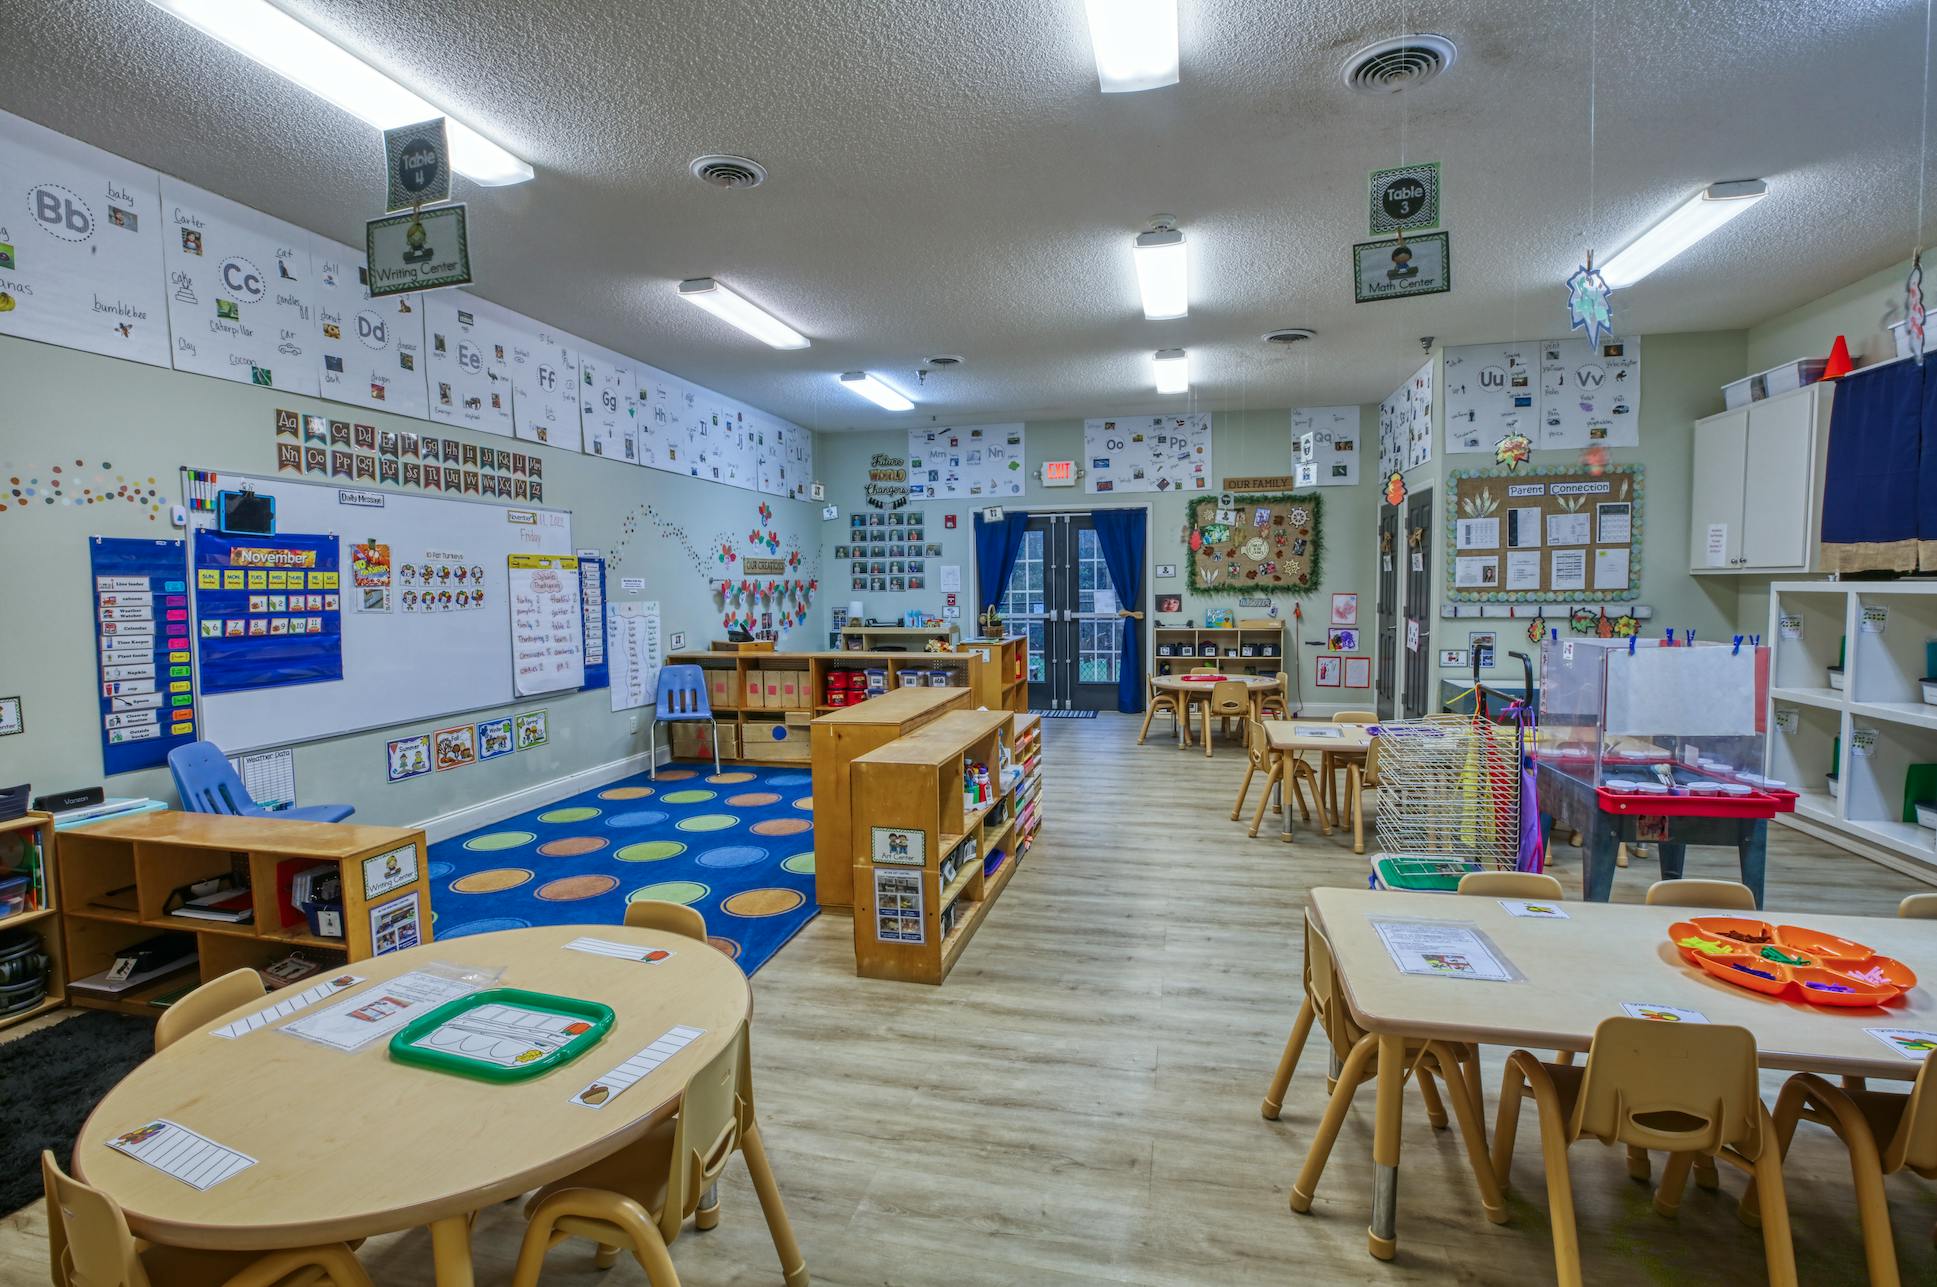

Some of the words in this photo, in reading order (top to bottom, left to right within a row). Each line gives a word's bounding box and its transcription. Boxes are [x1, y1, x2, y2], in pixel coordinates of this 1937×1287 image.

[401, 151, 437, 170] Table
[415, 169, 425, 185] 4
[105, 181, 134, 207] baby
[1387, 185, 1424, 201] Table
[36, 188, 90, 234] Bb
[1400, 200, 1410, 214] 3
[223, 263, 261, 295] Cc
[376, 266, 417, 283] Writing
[420, 260, 458, 276] Center
[1368, 281, 1396, 293] Math
[1399, 278, 1434, 290] Center
[91, 293, 147, 320] bumblebee
[358, 316, 385, 342] Dd
[458, 345, 481, 370] Ee
[539, 367, 556, 389] Ff
[1480, 371, 1504, 387] Uu
[1577, 371, 1603, 387] Vv
[602, 391, 617, 412] Gg
[654, 407, 667, 424] Hh
[278, 411, 297, 429] Aa
[332, 423, 348, 438] Cc
[356, 426, 371, 442] Dd
[382, 434, 394, 448] Ee
[423, 439, 438, 453] Gg
[445, 442, 458, 455] Hh
[466, 446, 473, 458] Ii
[482, 449, 492, 461] Jj
[499, 453, 510, 465] Kk
[1106, 439, 1124, 451] Oo
[1169, 436, 1187, 451] Pp
[1314, 432, 1332, 444] Qq
[929, 450, 947, 458] Mm
[988, 447, 1005, 458] Nn
[871, 453, 905, 468] Future
[282, 445, 298, 461] Nn
[307, 450, 325, 464] Oo
[335, 452, 351, 469] Pp
[357, 456, 373, 473] Qq
[382, 460, 397, 475] Rr
[406, 463, 418, 479] Ss
[427, 467, 437, 480] Tt
[446, 469, 459, 483] Uu
[466, 473, 477, 485] Vv
[483, 476, 495, 489] Ww
[499, 477, 511, 491] Xx
[515, 479, 526, 492] Yy
[531, 482, 540, 494] Zz
[868, 468, 907, 482] WORLD
[1047, 462, 1071, 480] EXIT
[864, 483, 911, 498] Changers
[1228, 480, 1250, 489] OUR
[1252, 479, 1288, 489] FAMILY
[1510, 486, 1543, 496] Parent
[1551, 483, 1610, 494] Connection
[341, 493, 358, 504] Daily
[520, 528, 541, 543] Friday
[242, 550, 308, 564] November
[746, 560, 758, 571] OUR
[758, 561, 785, 572] CREATIONS
[260, 600, 264, 608] 1
[331, 597, 337, 605] 5
[212, 623, 219, 631] 6
[280, 622, 286, 630] 9
[296, 622, 304, 630] 10
[399, 743, 420, 752] Summer
[246, 753, 274, 764] Weather
[274, 750, 290, 758] Data
[881, 852, 893, 860] Art
[893, 852, 915, 861] Center
[368, 879, 393, 894] Writing
[393, 871, 414, 882] Center
